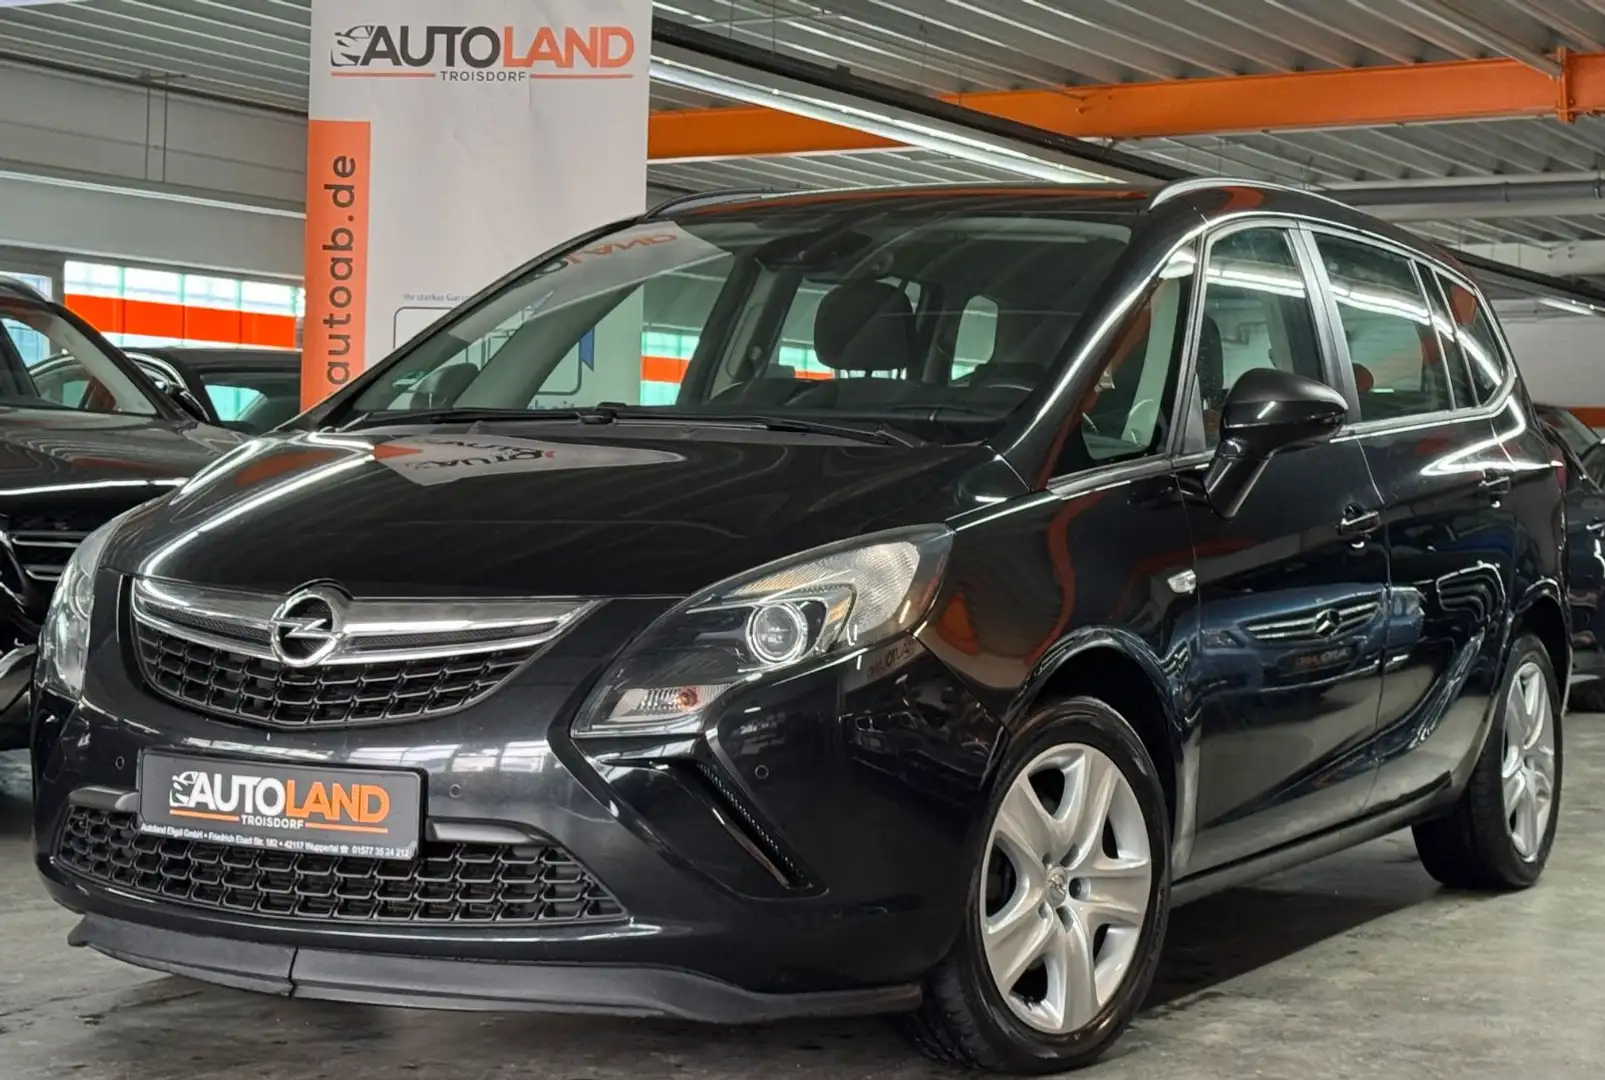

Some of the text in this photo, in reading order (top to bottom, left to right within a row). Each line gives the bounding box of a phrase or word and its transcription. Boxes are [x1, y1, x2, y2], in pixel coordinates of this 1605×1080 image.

[360, 25, 635, 69] AUTOLAND
[440, 70, 527, 82] TROISDORF
[322, 155, 356, 385] autoab.de
[188, 772, 390, 823] AUTOLAND
[141, 823, 166, 835] Autoland
[184, 828, 203, 840] GmbH
[305, 842, 339, 854] Wuppertal
[241, 815, 305, 830] TROISDORF
